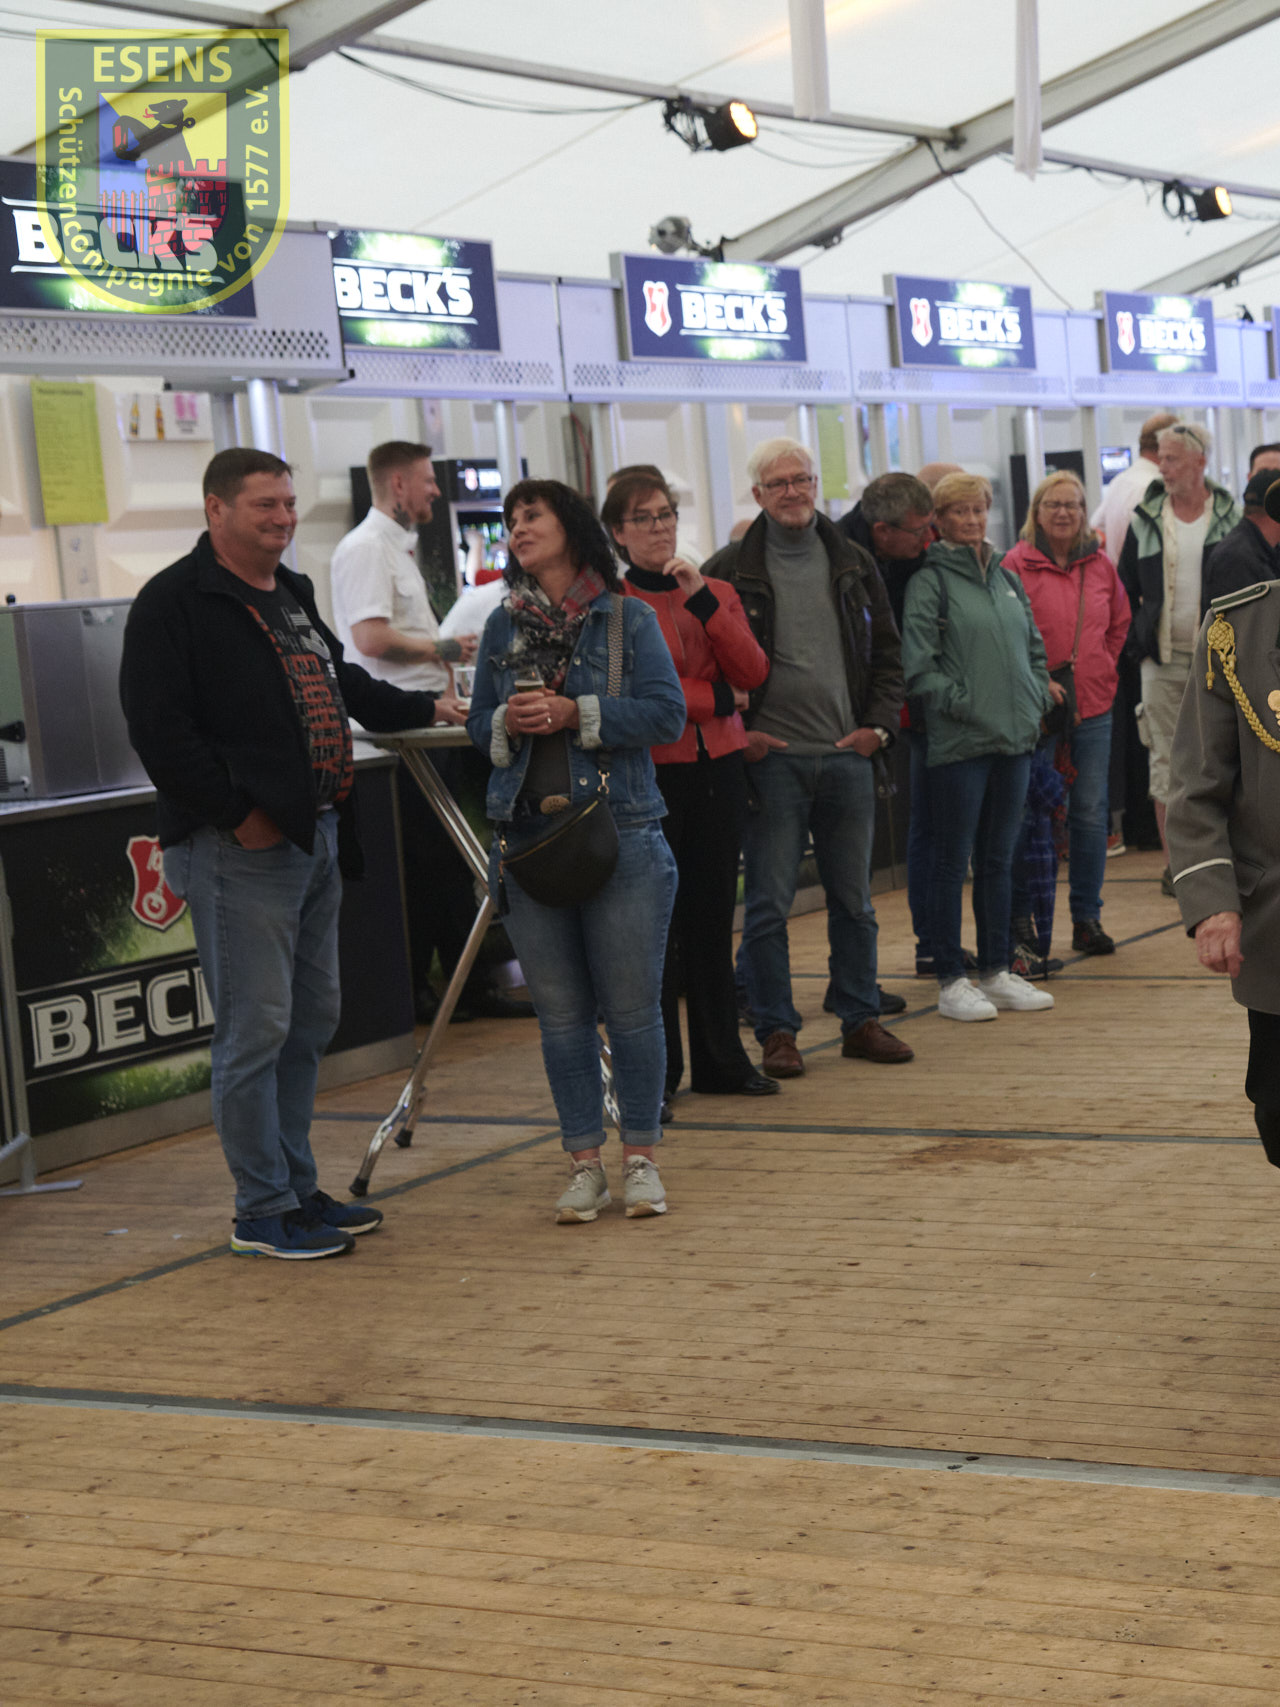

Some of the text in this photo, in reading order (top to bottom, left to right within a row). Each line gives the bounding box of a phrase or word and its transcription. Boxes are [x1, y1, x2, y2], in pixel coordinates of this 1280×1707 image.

[333, 267, 475, 316] BECK'S
[680, 291, 789, 334] BECK'S
[938, 307, 1022, 344] BECK'S
[289, 653, 344, 775] EIGHTY
